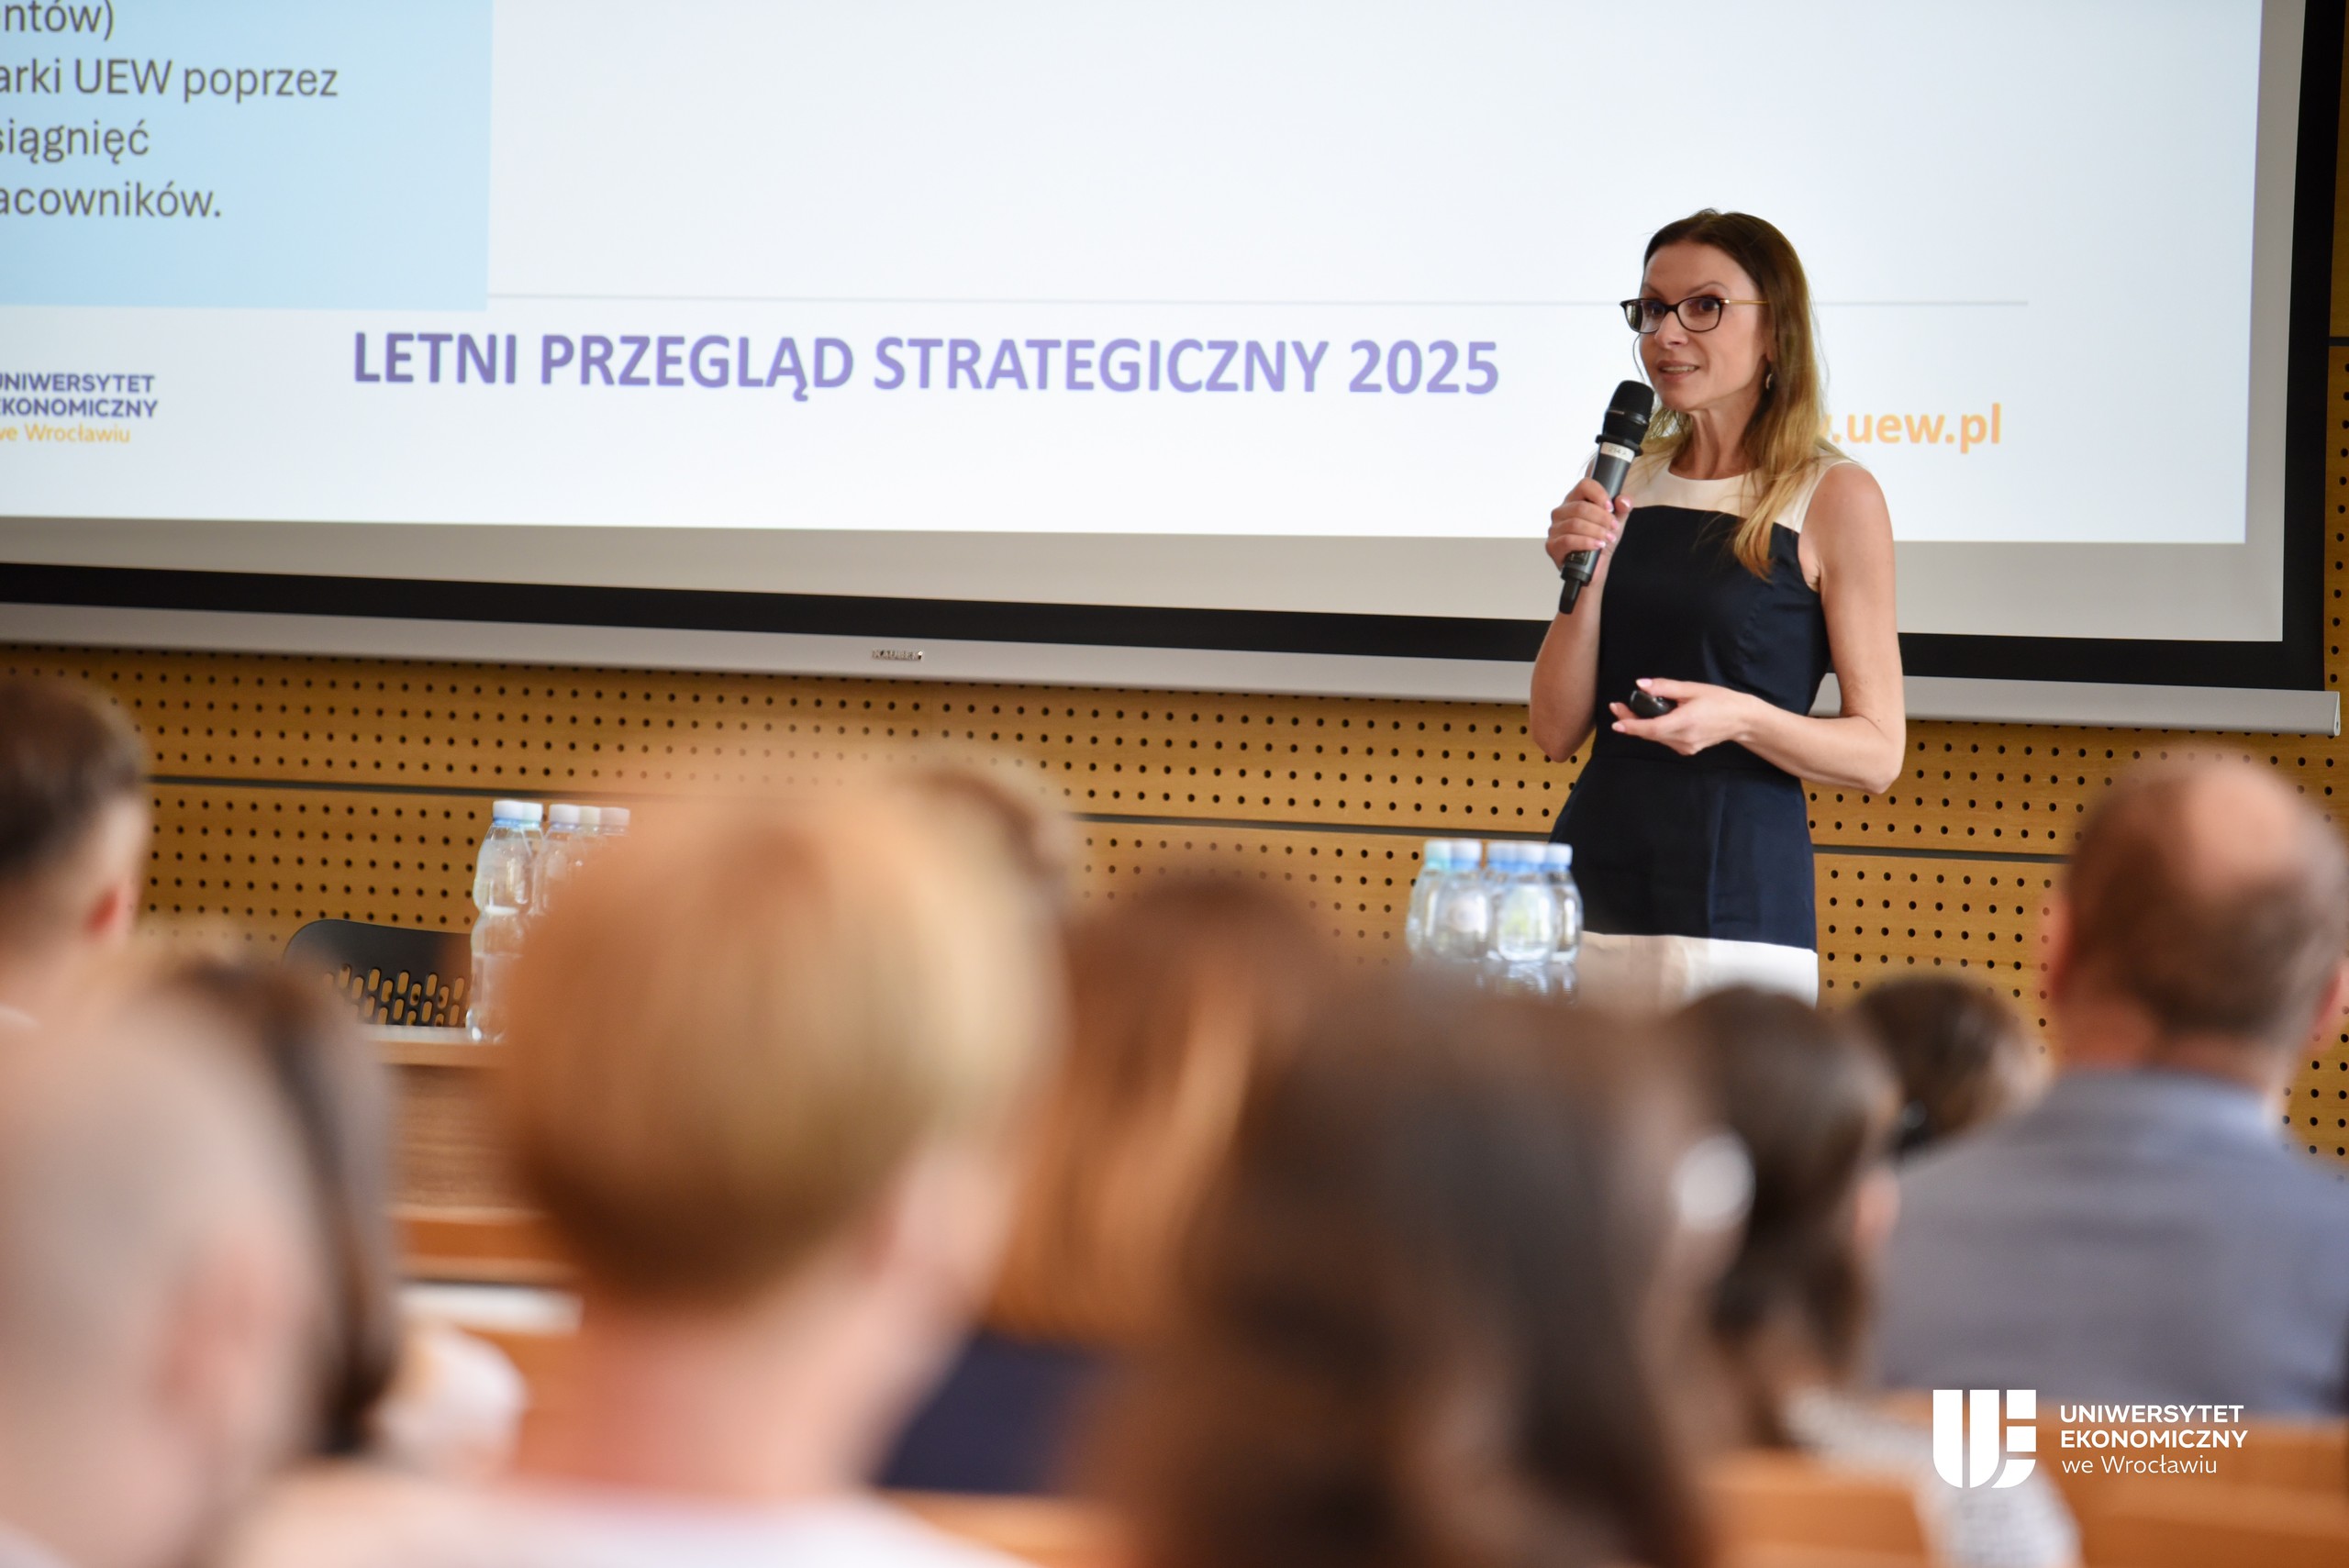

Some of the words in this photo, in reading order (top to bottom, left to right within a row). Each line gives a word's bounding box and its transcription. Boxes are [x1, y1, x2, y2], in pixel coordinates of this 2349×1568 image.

[74, 59, 173, 95] UEW
[184, 68, 339, 104] poprzez
[0, 118, 149, 164] iągnięć
[354, 331, 517, 384] LETNI
[540, 334, 854, 402] PRZEGLĄD
[874, 336, 1330, 394] STRATEGICZNY
[1349, 339, 1499, 395] 2025
[0, 373, 155, 393] NIWERSYTET
[0, 397, 158, 417] KONOMICZNY
[24, 423, 131, 442] Wrocławiu
